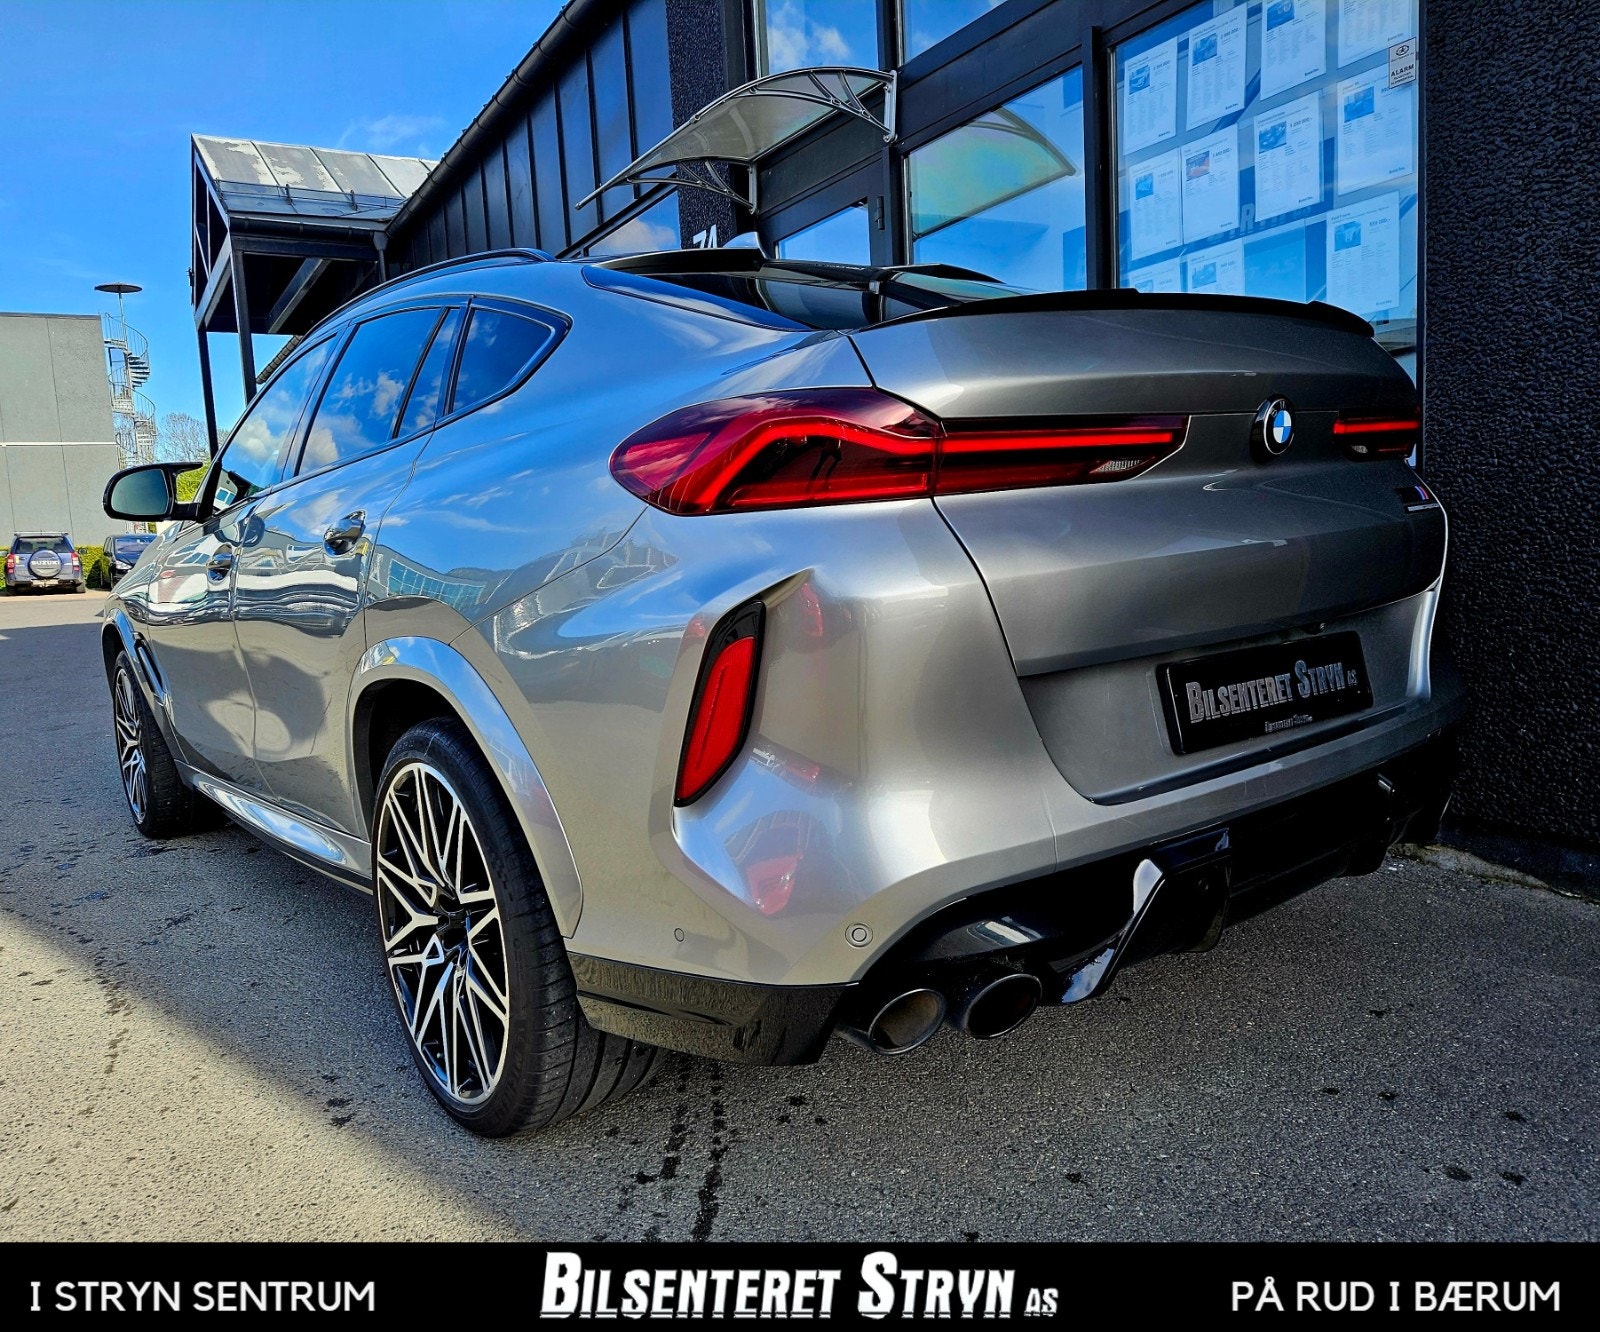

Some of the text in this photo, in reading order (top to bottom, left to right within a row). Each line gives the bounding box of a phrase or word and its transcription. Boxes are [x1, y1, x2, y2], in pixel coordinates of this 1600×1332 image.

[1391, 64, 1414, 77] ALARM
[1185, 673, 1294, 724] BILSENTERET
[1294, 660, 1345, 698] STRYN
